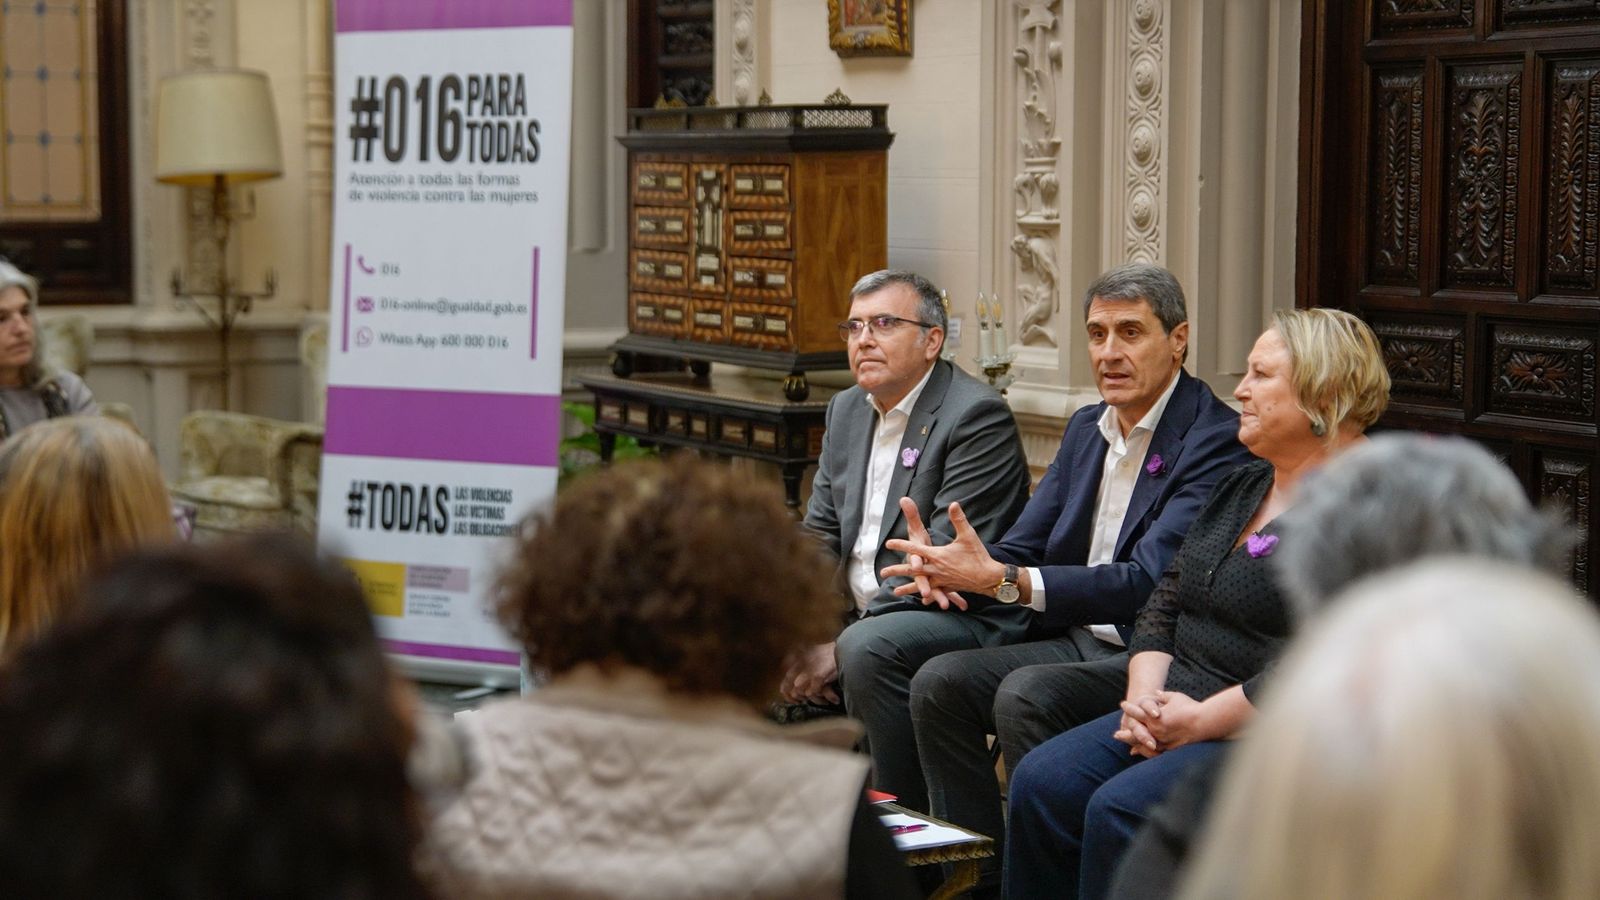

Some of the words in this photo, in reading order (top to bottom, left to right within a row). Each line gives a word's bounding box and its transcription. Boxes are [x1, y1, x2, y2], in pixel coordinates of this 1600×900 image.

[466, 73, 527, 116] PARA
[348, 73, 464, 163] #016
[466, 119, 541, 163] TODAS
[420, 172, 453, 186] todas
[457, 172, 473, 185] las
[478, 172, 520, 185] formas
[349, 188, 362, 201] de
[368, 188, 420, 201] violencia
[424, 190, 465, 202] contra
[470, 188, 485, 202] las
[490, 189, 538, 206] mujeres
[455, 486, 468, 500] LAS
[471, 487, 512, 504] VIOLENCIAS
[347, 480, 448, 535] #TODAS
[454, 505, 468, 518] LAS
[454, 521, 468, 536] LAS
